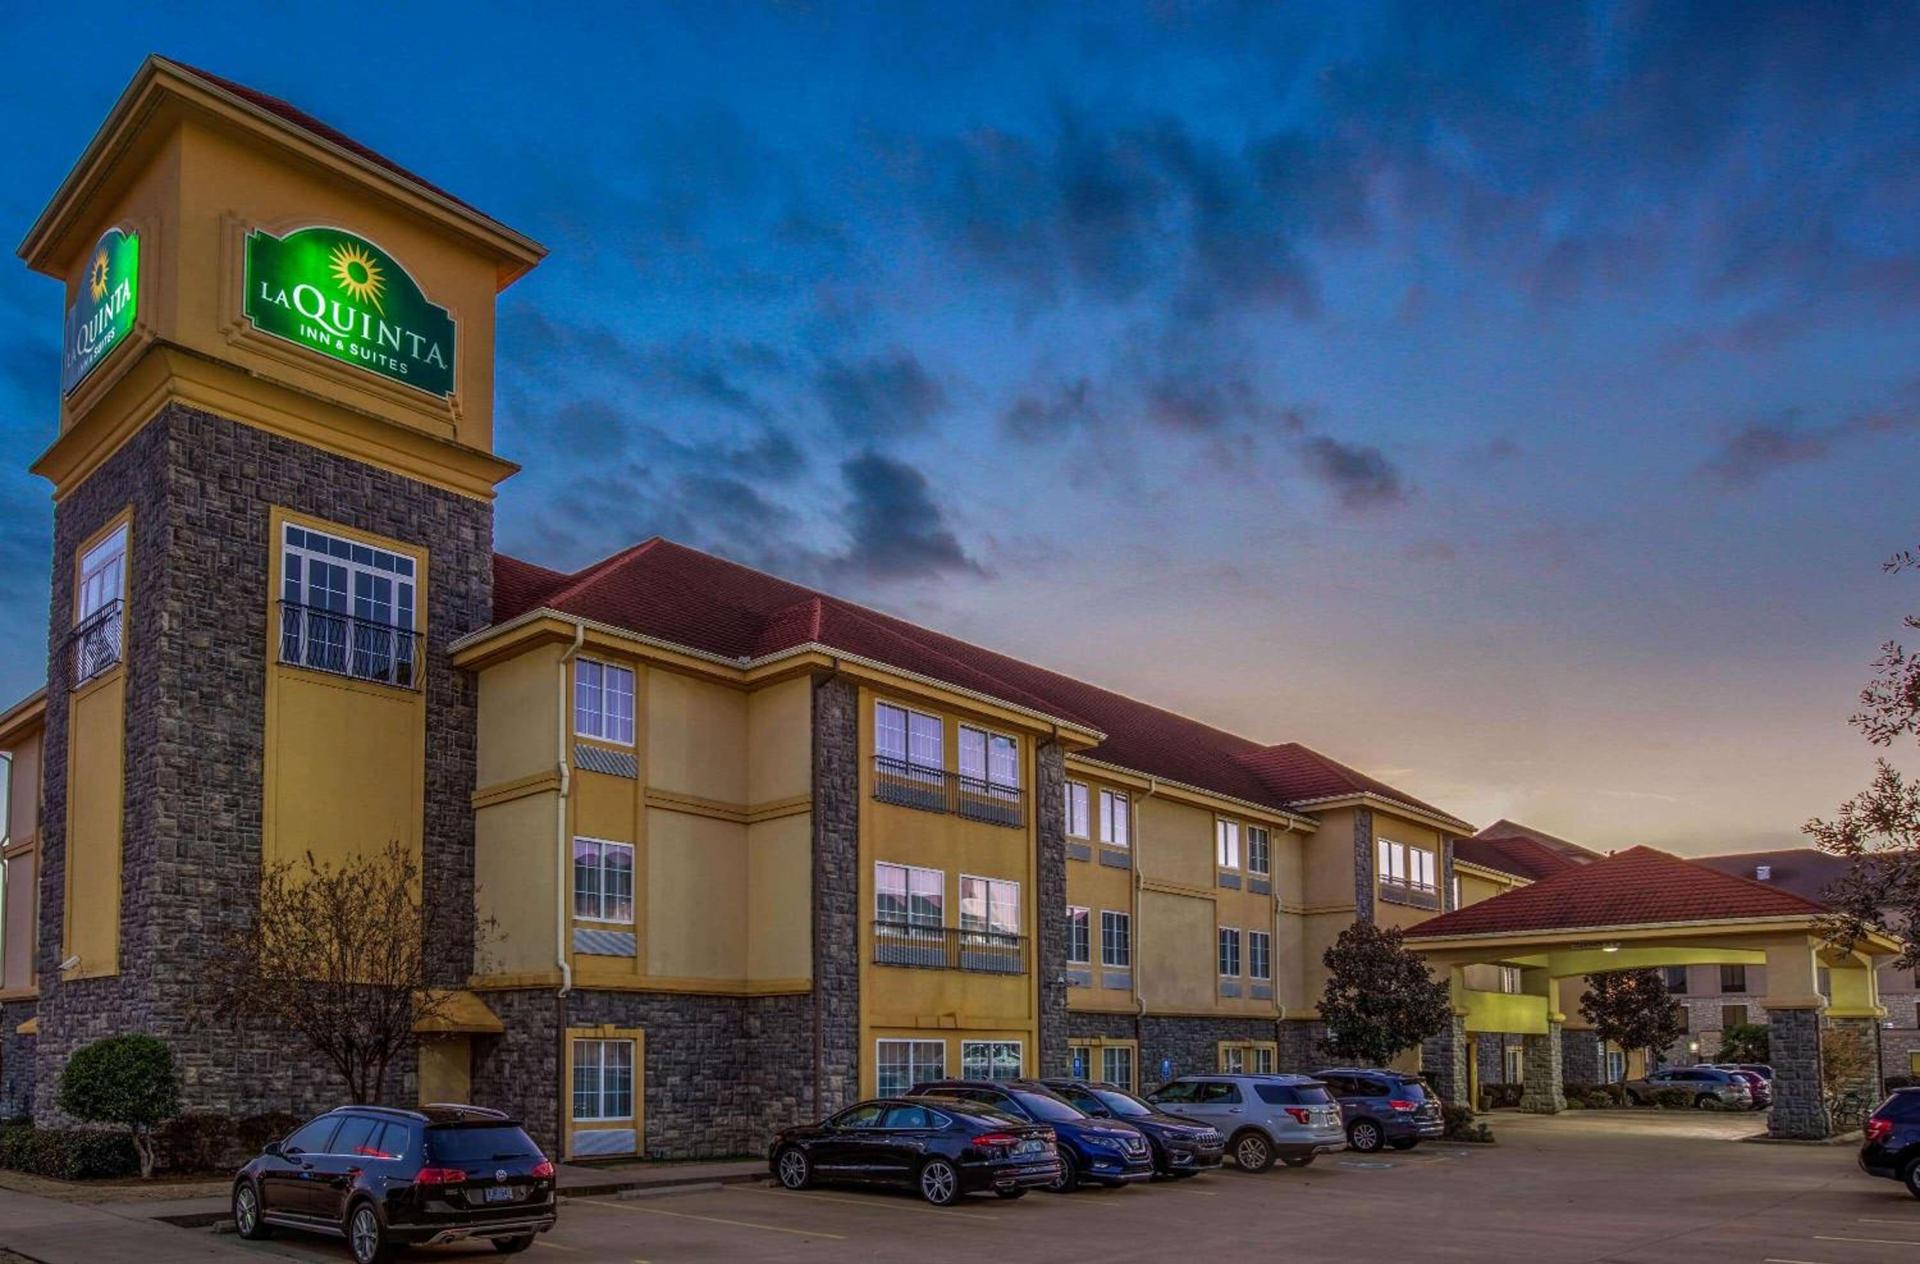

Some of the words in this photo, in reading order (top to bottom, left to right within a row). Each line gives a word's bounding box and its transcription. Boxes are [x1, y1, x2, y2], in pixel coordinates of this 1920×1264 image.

[77, 277, 131, 356] QUINTA
[260, 281, 291, 310] LA
[292, 283, 448, 370] QUINTA
[300, 324, 331, 346] INN
[335, 339, 344, 351] &
[349, 342, 408, 375] SUITES
